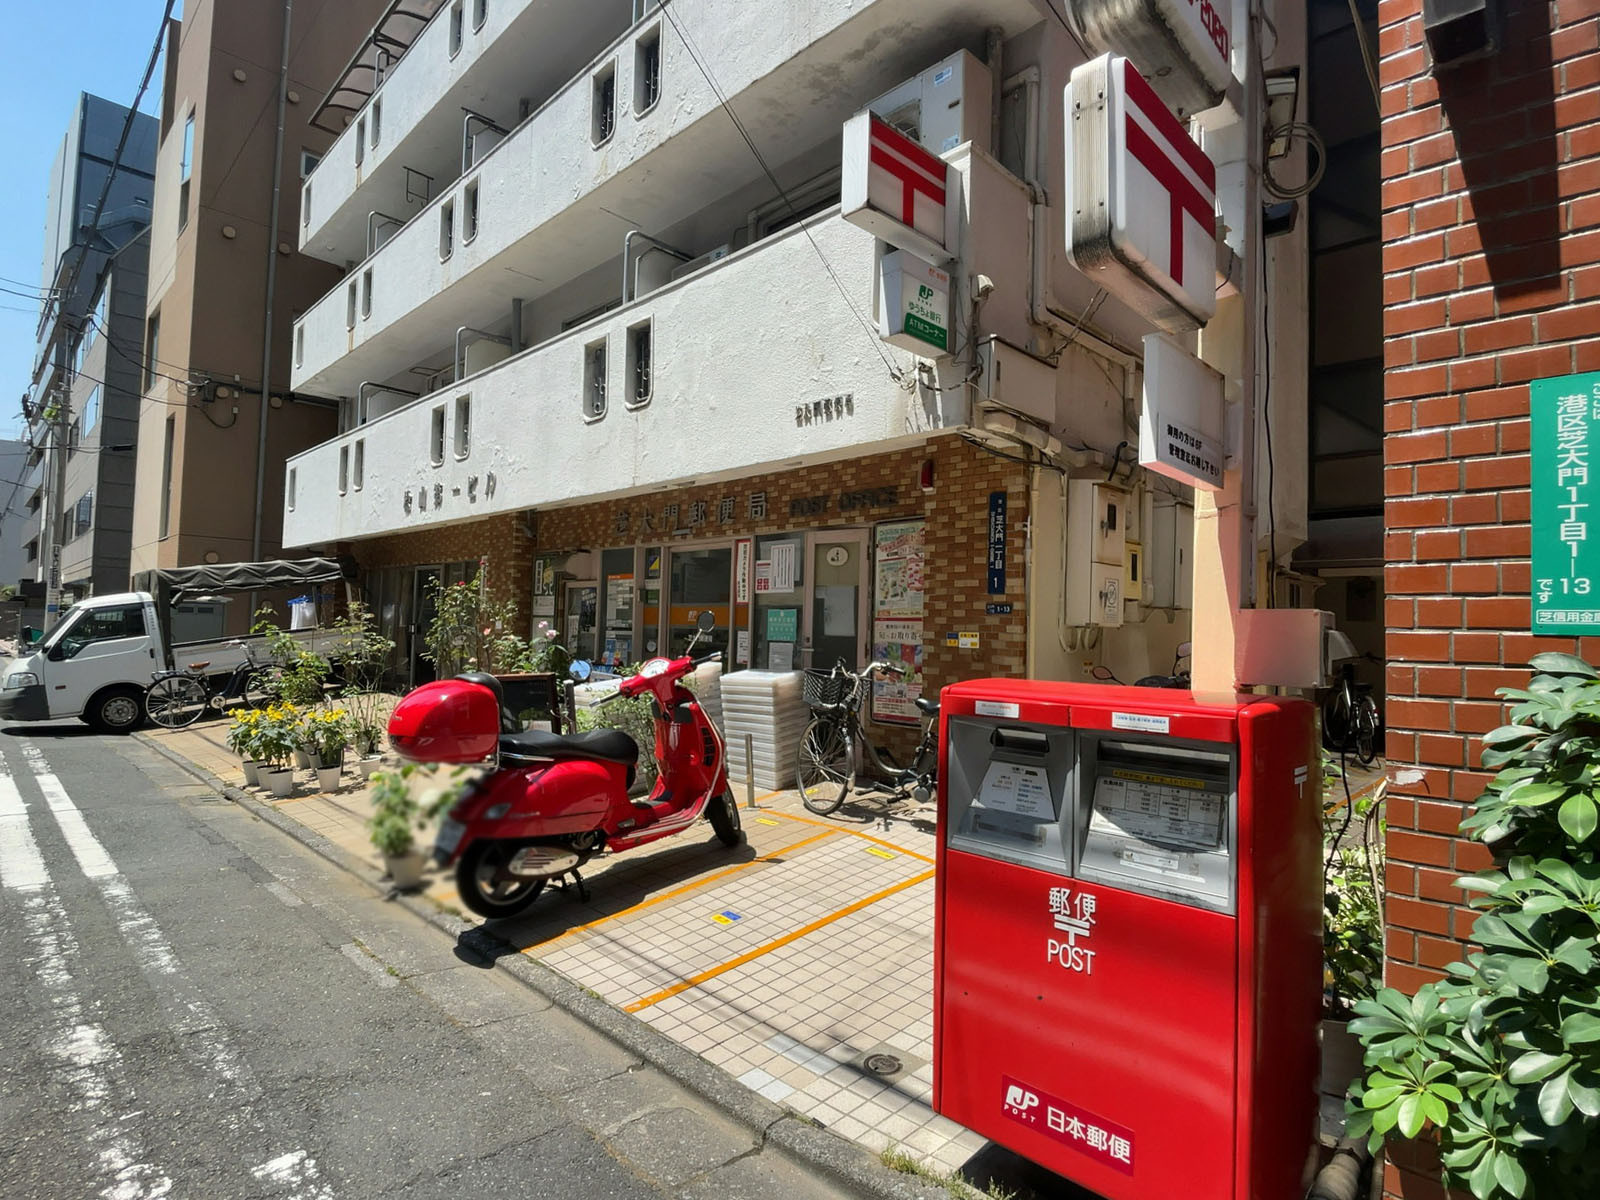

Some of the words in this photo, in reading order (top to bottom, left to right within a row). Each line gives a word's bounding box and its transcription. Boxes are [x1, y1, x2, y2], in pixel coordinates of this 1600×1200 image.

[908, 301, 942, 324] ゆうちょ銀行
[909, 318, 945, 338] ATMコーナー
[1536, 579, 1553, 604] です
[1049, 887, 1096, 924] 郵便
[1048, 939, 1096, 975] POST
[1003, 1103, 1036, 1123] POST
[1047, 1105, 1131, 1165] 日本郵便
